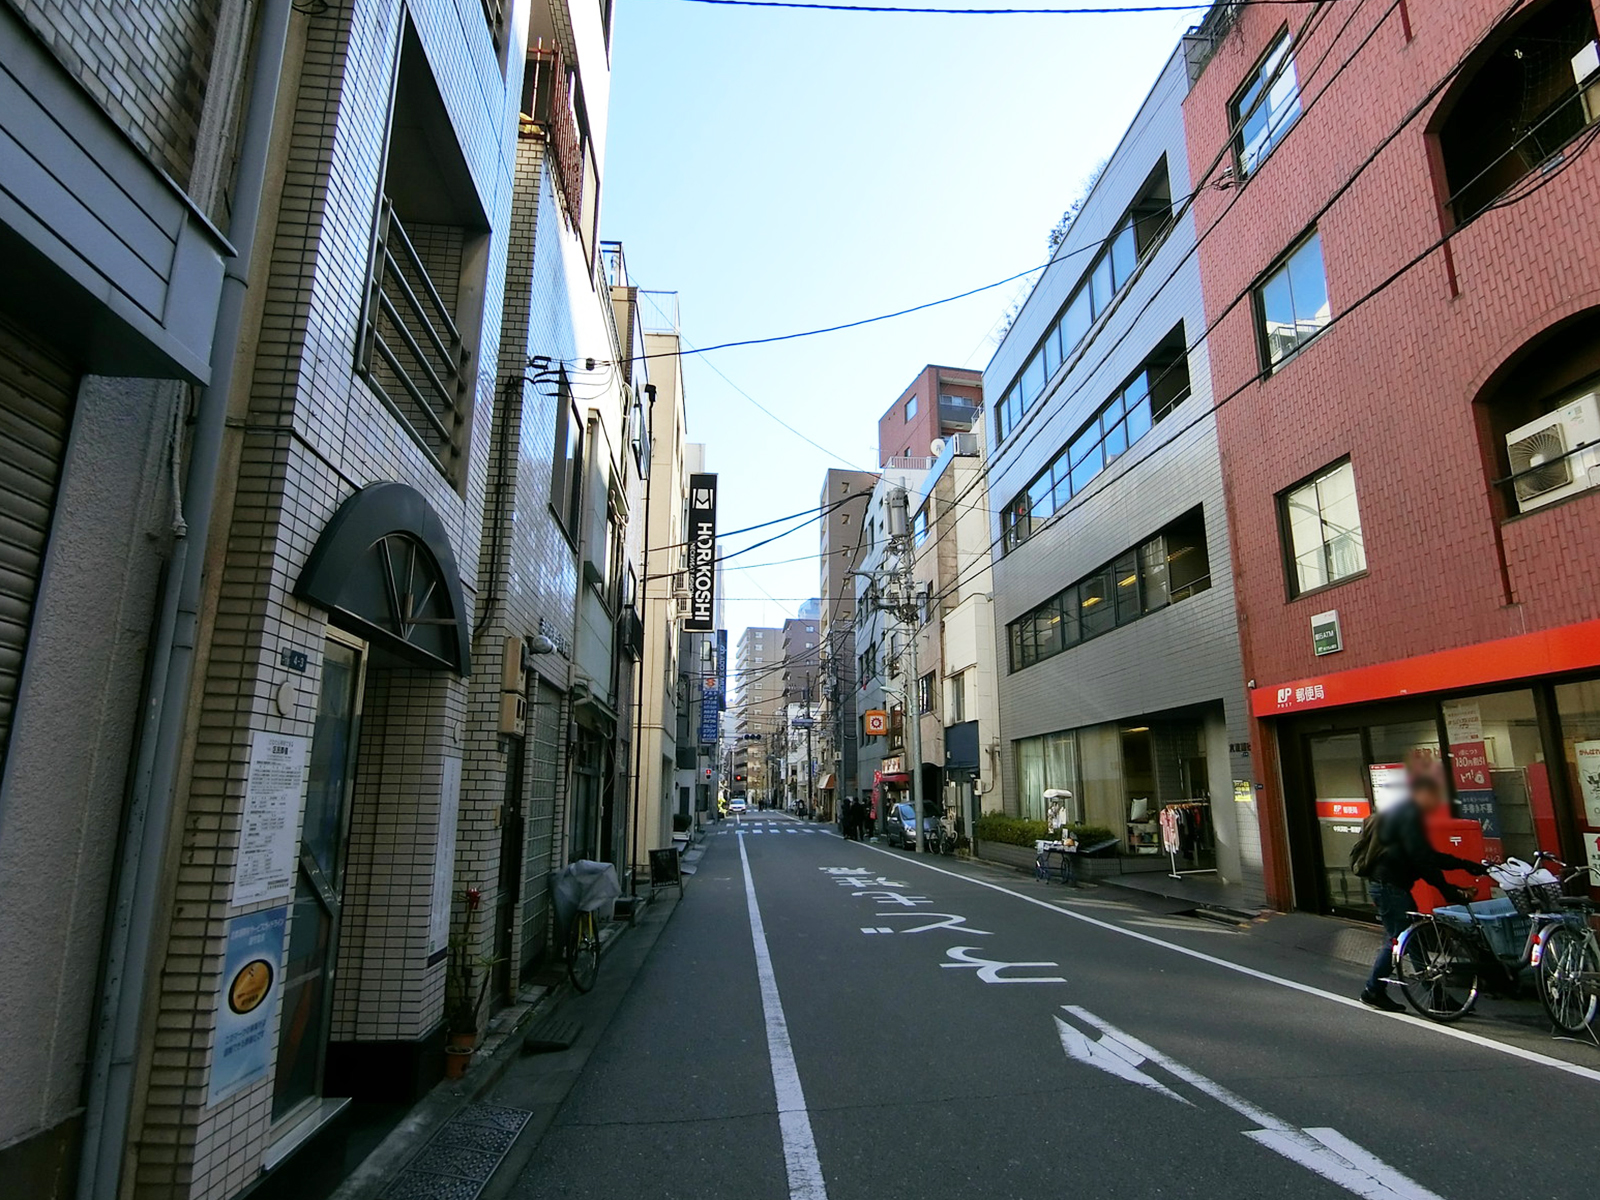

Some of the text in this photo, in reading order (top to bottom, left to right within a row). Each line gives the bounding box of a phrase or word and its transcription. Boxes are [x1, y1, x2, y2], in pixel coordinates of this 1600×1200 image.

[695, 522, 713, 621] HORIKOSHI
[1295, 684, 1325, 702] 郵便局
